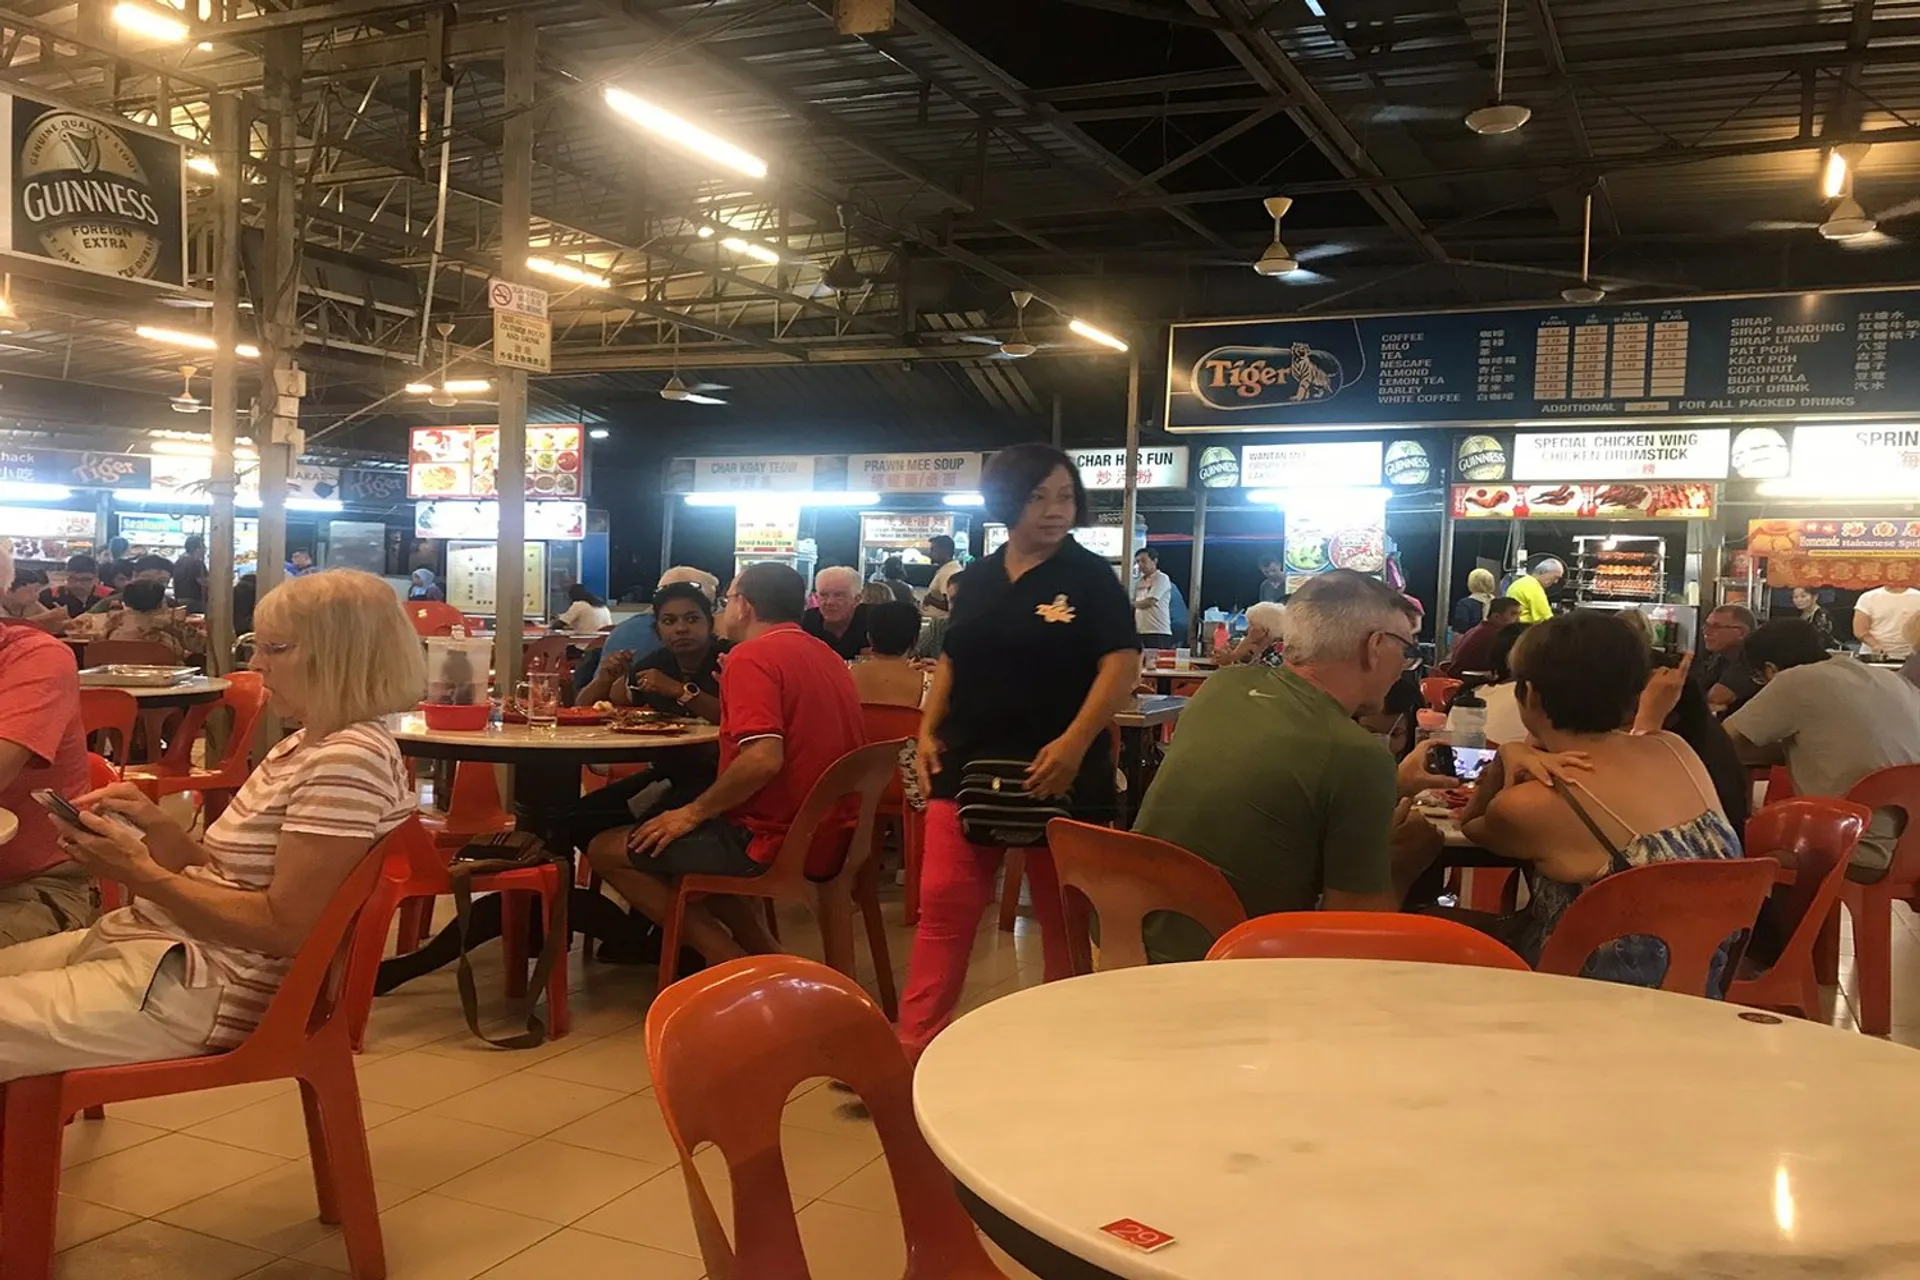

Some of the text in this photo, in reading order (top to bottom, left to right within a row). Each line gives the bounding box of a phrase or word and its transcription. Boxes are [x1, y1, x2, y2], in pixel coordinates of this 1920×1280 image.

[29, 123, 59, 166] GENUINE
[113, 141, 139, 174] STOUT
[23, 180, 159, 225] GUINNESS
[71, 224, 133, 239] FOREIGN
[82, 238, 128, 250] EXTRA
[1731, 317, 1773, 327] SIRAP
[1730, 323, 1846, 337] SIRAP BANDUNG
[1381, 333, 1424, 342] COFFEE
[1729, 334, 1820, 347] SIRAP LIMAU
[1380, 343, 1410, 351] MILO
[1729, 345, 1789, 356] PAT POH
[1381, 351, 1402, 360] TEA
[1729, 355, 1797, 365] KEAT POH
[1379, 359, 1432, 369] NESCAFE
[1728, 364, 1794, 375] COCONUT
[1379, 368, 1429, 377] ALMOND
[1206, 360, 1292, 397] Tiger
[1379, 376, 1445, 387] LEMON TEA
[1727, 374, 1807, 385] BUAH PALA
[1378, 386, 1424, 395] BARLEY
[1727, 383, 1810, 394] SOFT DRINK
[1378, 393, 1461, 404] WHITE COFFEE
[1679, 396, 1856, 410] FOR ALL PACKED DRINKS
[1541, 403, 1616, 413] ADDITIONAL
[1534, 433, 1698, 450] SPECIAL CHICKEN WING
[1077, 452, 1173, 467] CHAR HR FUN
[1604, 448, 1688, 461] DRUMSTICK
[864, 458, 964, 472] PRAWN MEE SOUP
[1385, 457, 1430, 475] GUINNESS
[1458, 452, 1506, 472] GUINNESS
[1199, 462, 1239, 480] GUINNESS
[1842, 538, 1895, 547] Hainanese
